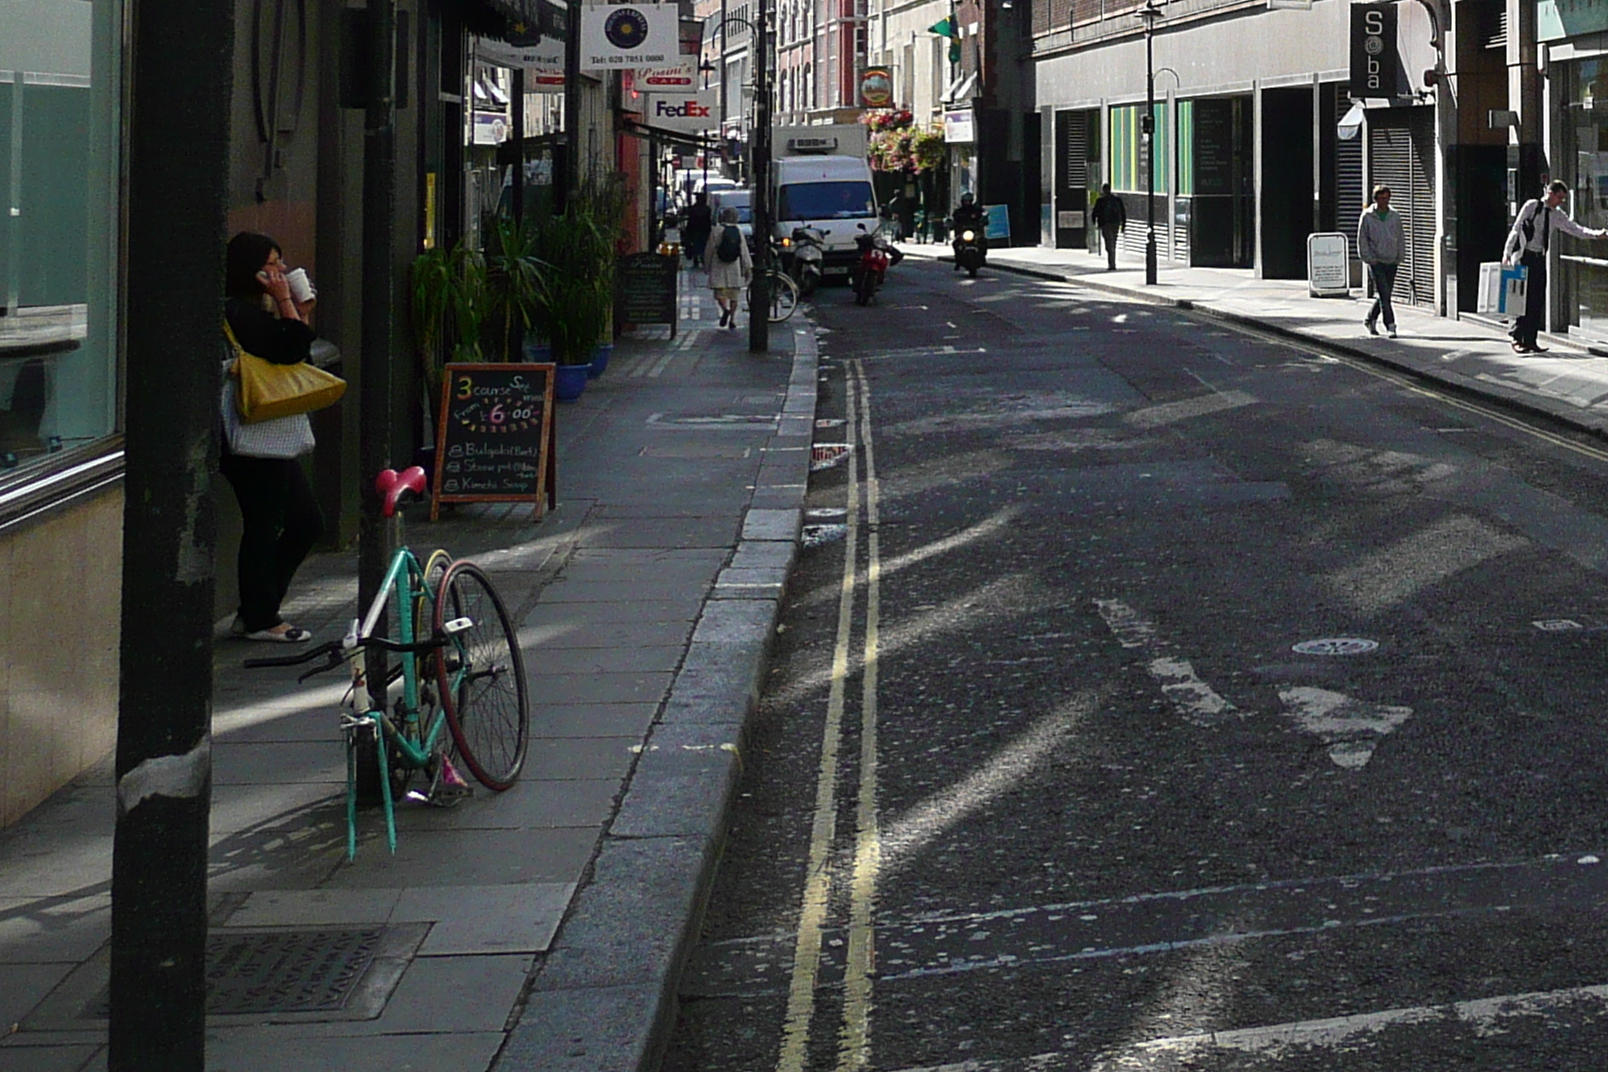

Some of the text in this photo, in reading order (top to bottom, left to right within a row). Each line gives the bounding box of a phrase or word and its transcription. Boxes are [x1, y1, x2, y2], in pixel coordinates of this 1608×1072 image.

[656, 100, 710, 117] FedEx
[456, 375, 472, 400] 3
[473, 385, 512, 396] course
